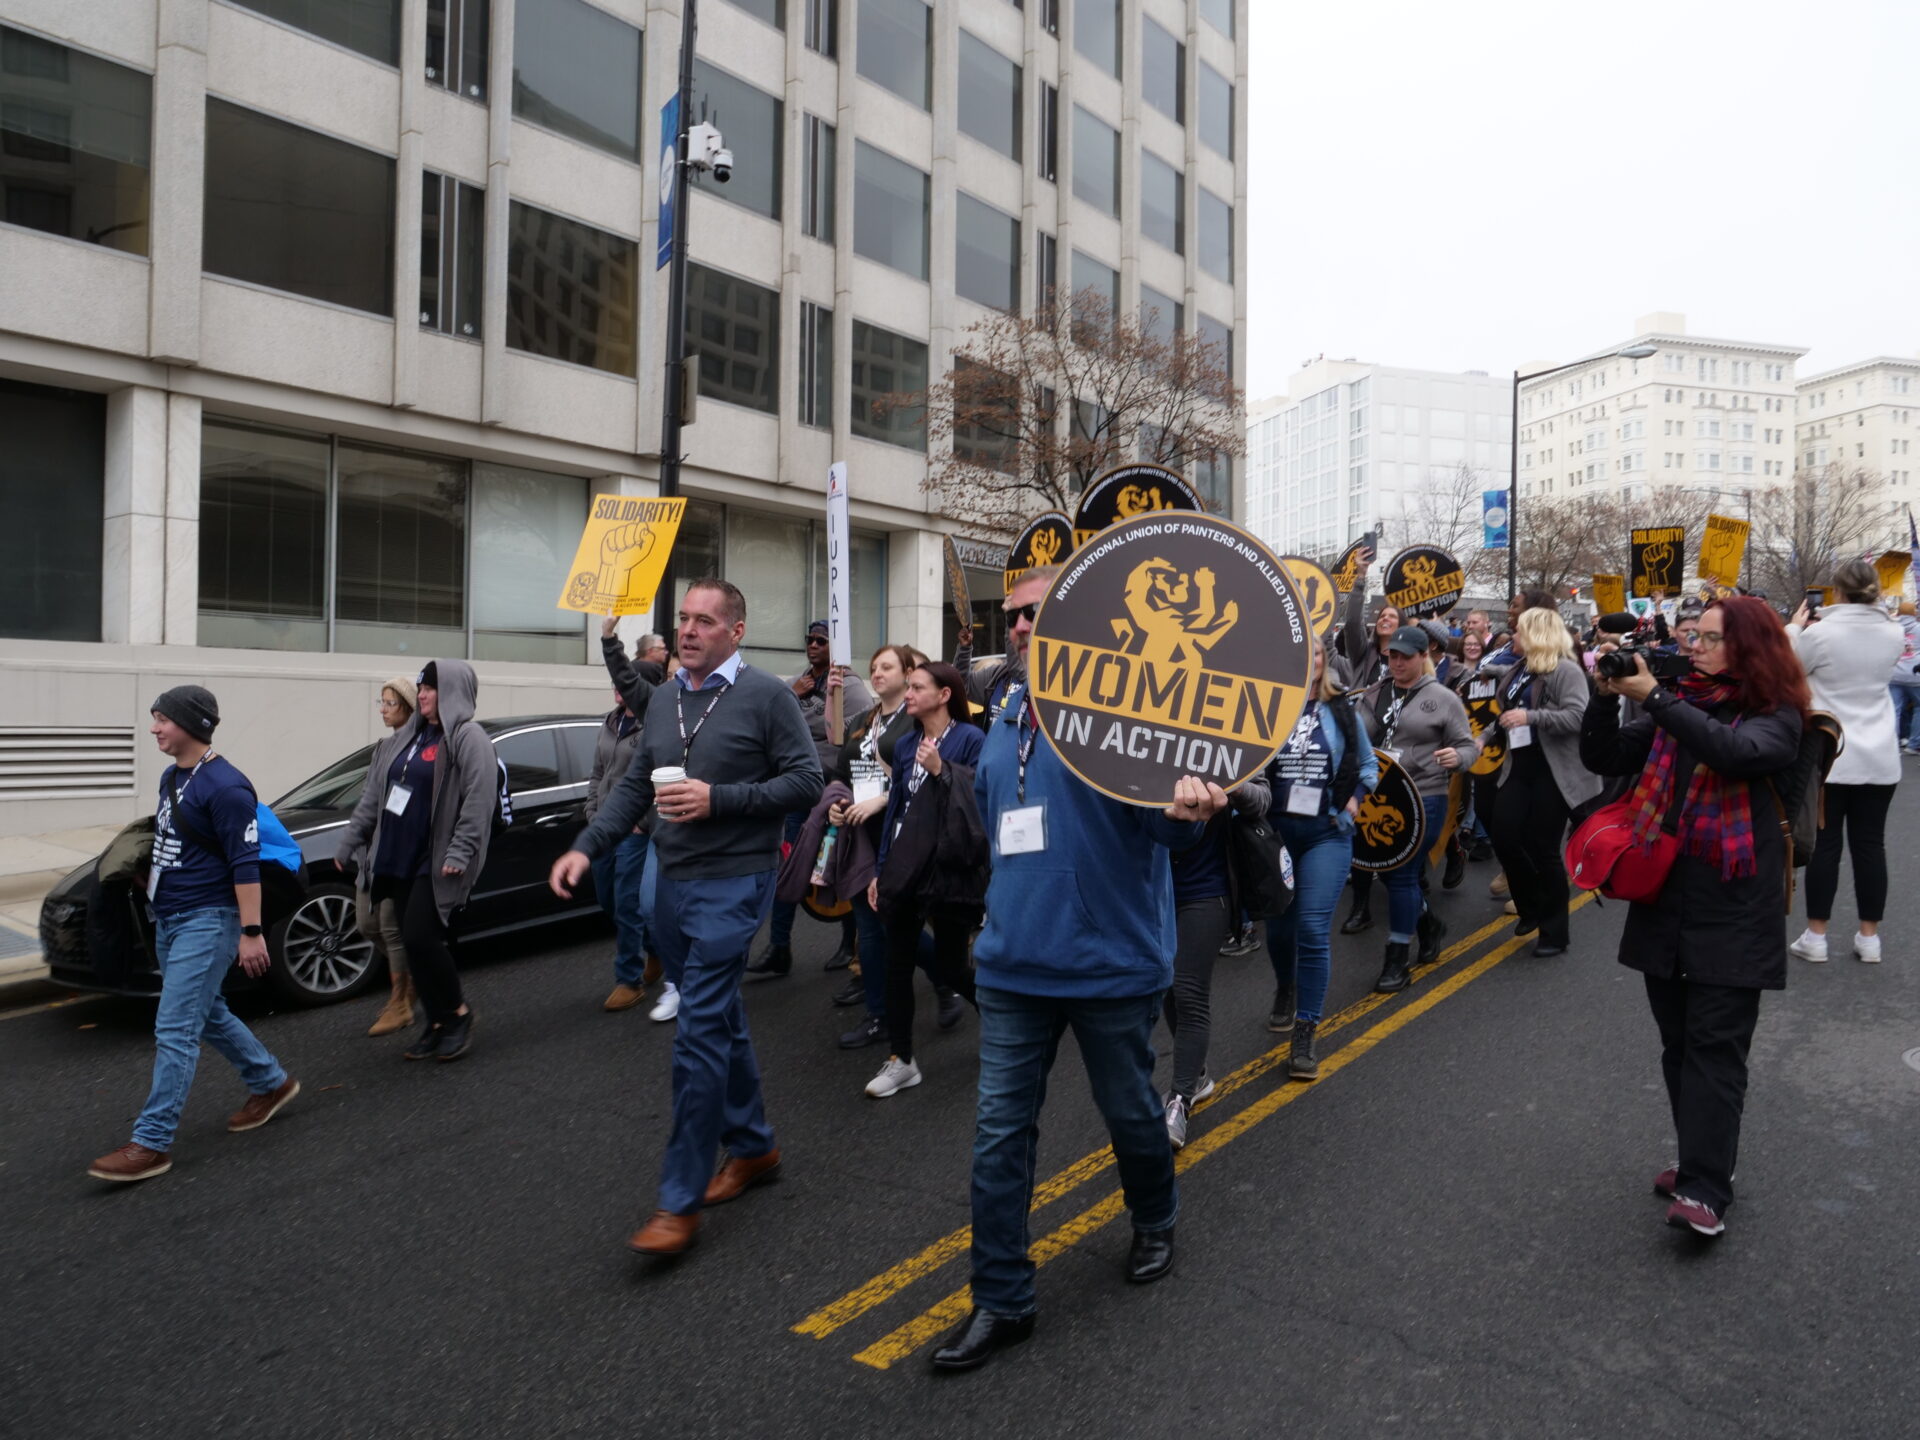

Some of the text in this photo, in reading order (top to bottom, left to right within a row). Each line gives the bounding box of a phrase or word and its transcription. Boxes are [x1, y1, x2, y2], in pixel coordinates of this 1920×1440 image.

[595, 499, 682, 522] SOLIDARITY!
[1632, 528, 1683, 544] SOLIDARITY!
[830, 514, 839, 640] IUPAT
[1056, 536, 1126, 601] INTERNATIONAL
[1126, 525, 1162, 542] UNION
[1164, 524, 1179, 533] OF
[1182, 524, 1235, 547] PAINTERS
[1234, 542, 1258, 563] AND
[1256, 560, 1287, 596] ALLIED
[1281, 594, 1303, 644] TRADES
[1389, 573, 1461, 608] WOMEN
[1403, 590, 1458, 618] IN ACTION
[1038, 640, 1283, 741] WOMEN
[1054, 709, 1093, 746] IN
[1100, 721, 1242, 780] ACTION
